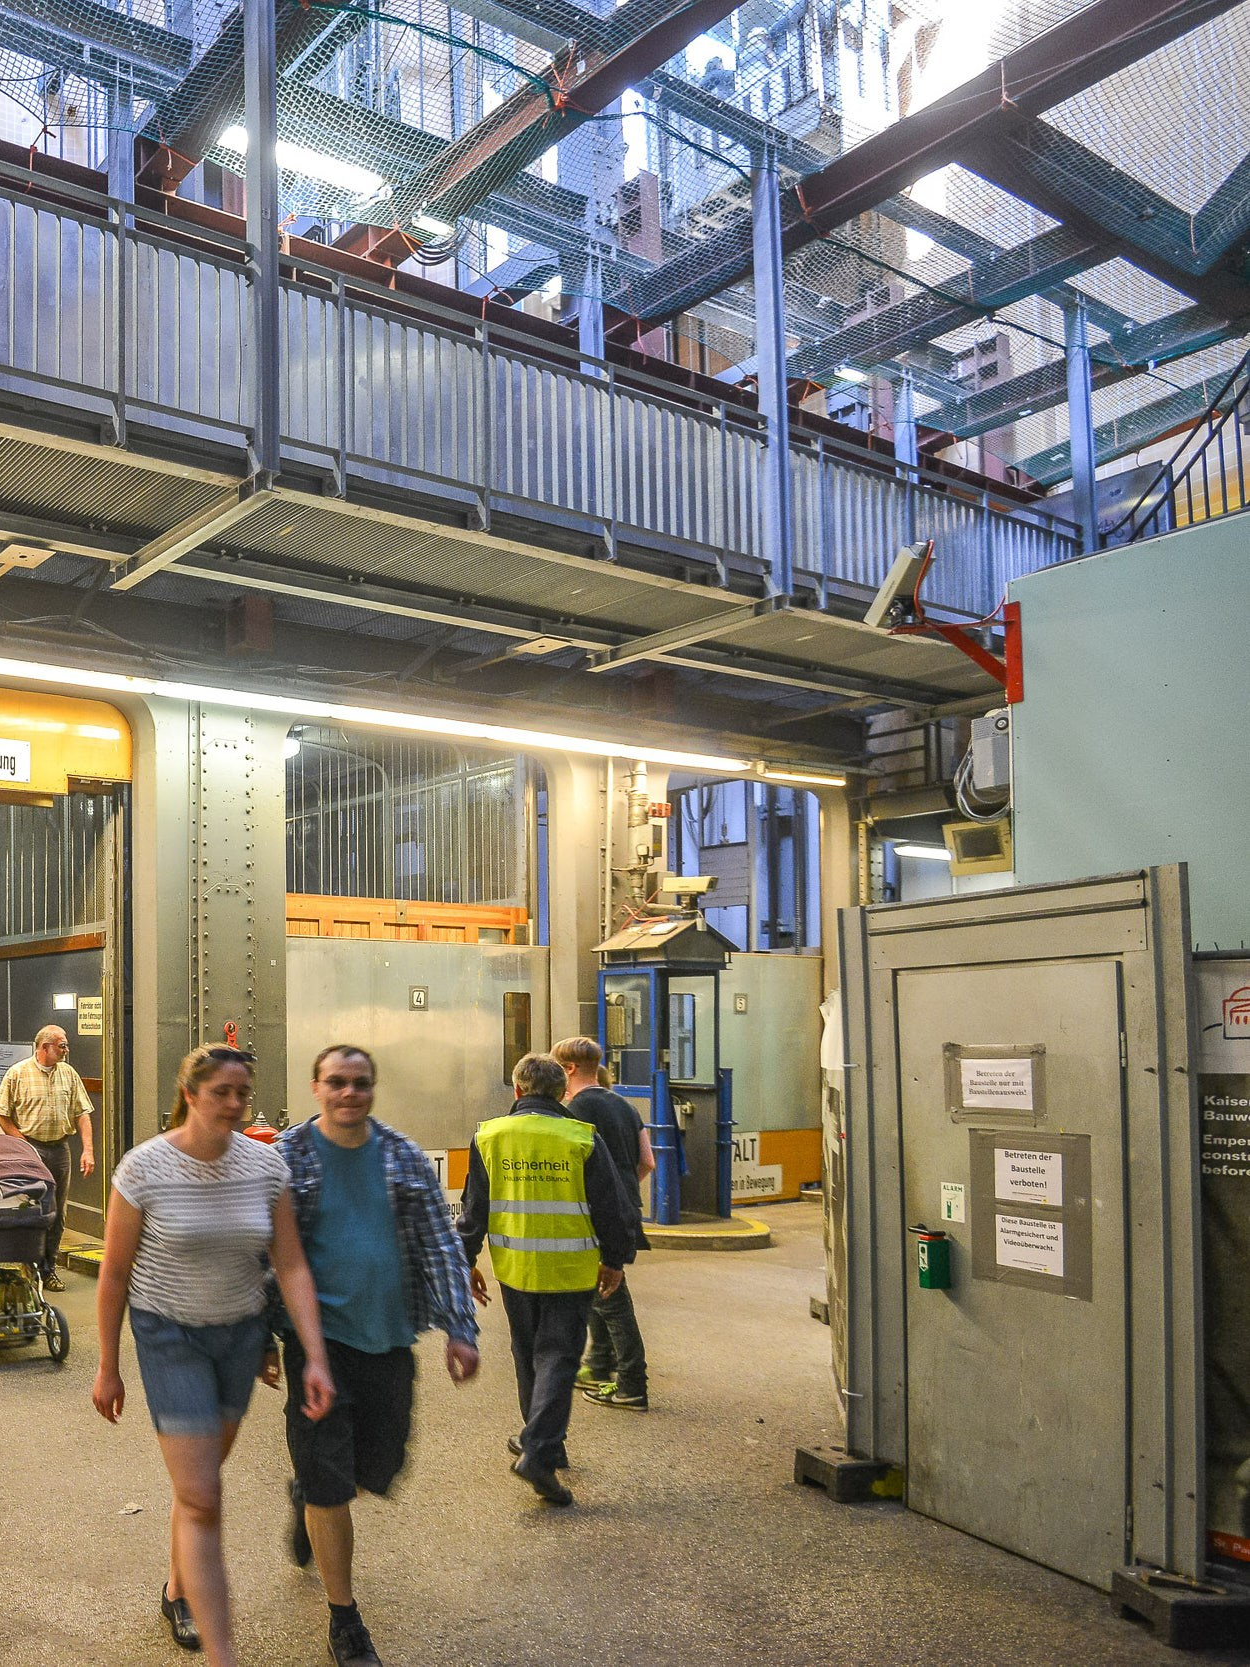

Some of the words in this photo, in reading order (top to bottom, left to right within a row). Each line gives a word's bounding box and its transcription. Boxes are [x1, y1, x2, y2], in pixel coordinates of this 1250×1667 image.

[415, 992, 422, 1004] 4
[1204, 1095, 1250, 1106] Kaise
[1203, 1110, 1250, 1122] Bauw
[733, 1138, 757, 1162] ALT
[1004, 1150, 1037, 1160] Betreten
[1038, 1153, 1053, 1161] der
[502, 1158, 570, 1171] Sicherheit
[1011, 1165, 1046, 1175] Baustelle
[746, 1175, 775, 1192] Bewegung
[942, 1184, 963, 1192] ALARM
[1010, 1179, 1047, 1189] verboten!
[1001, 1217, 1018, 1225] Diese
[1019, 1219, 1047, 1229] Baustelle
[1000, 1227, 1045, 1239] Alarmgesichert
[1003, 1238, 1055, 1252] Videoüberwacht.
